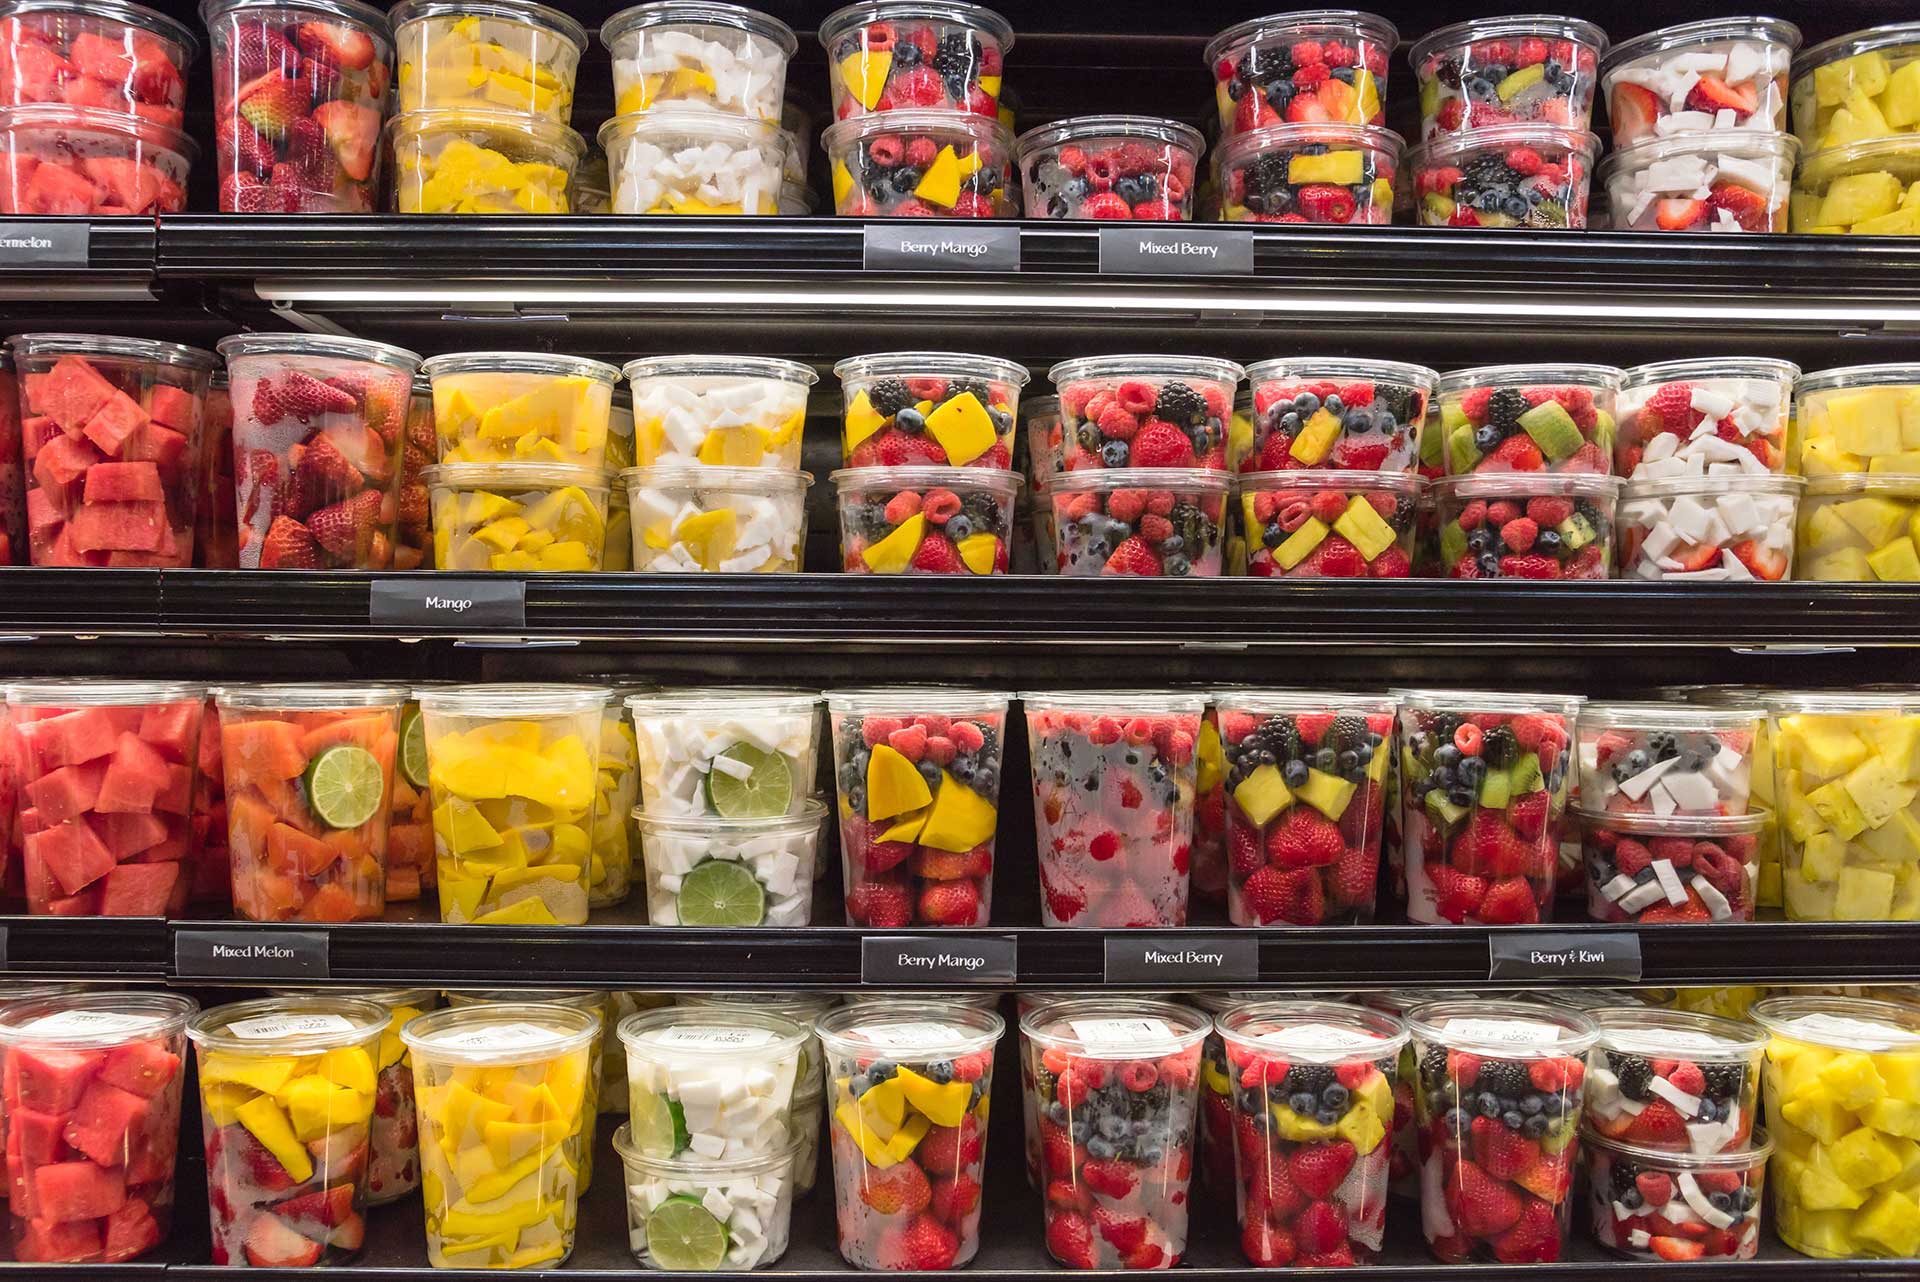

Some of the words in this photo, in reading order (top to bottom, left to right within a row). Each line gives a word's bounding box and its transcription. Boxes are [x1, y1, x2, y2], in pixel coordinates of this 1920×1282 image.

[901, 240, 938, 256] Berry
[941, 241, 988, 257] Mango
[1139, 241, 1178, 254] Mixed
[1181, 242, 1218, 258] Berry
[425, 596, 472, 612] Mango
[212, 945, 251, 958] Mixed
[254, 945, 294, 958] Melon
[1144, 951, 1183, 963] Mixed
[1186, 951, 1223, 966] Berry
[1531, 951, 1567, 966] Berry
[1579, 950, 1605, 963] Kiwi
[898, 953, 936, 969] Berry
[938, 954, 985, 970] Mango
